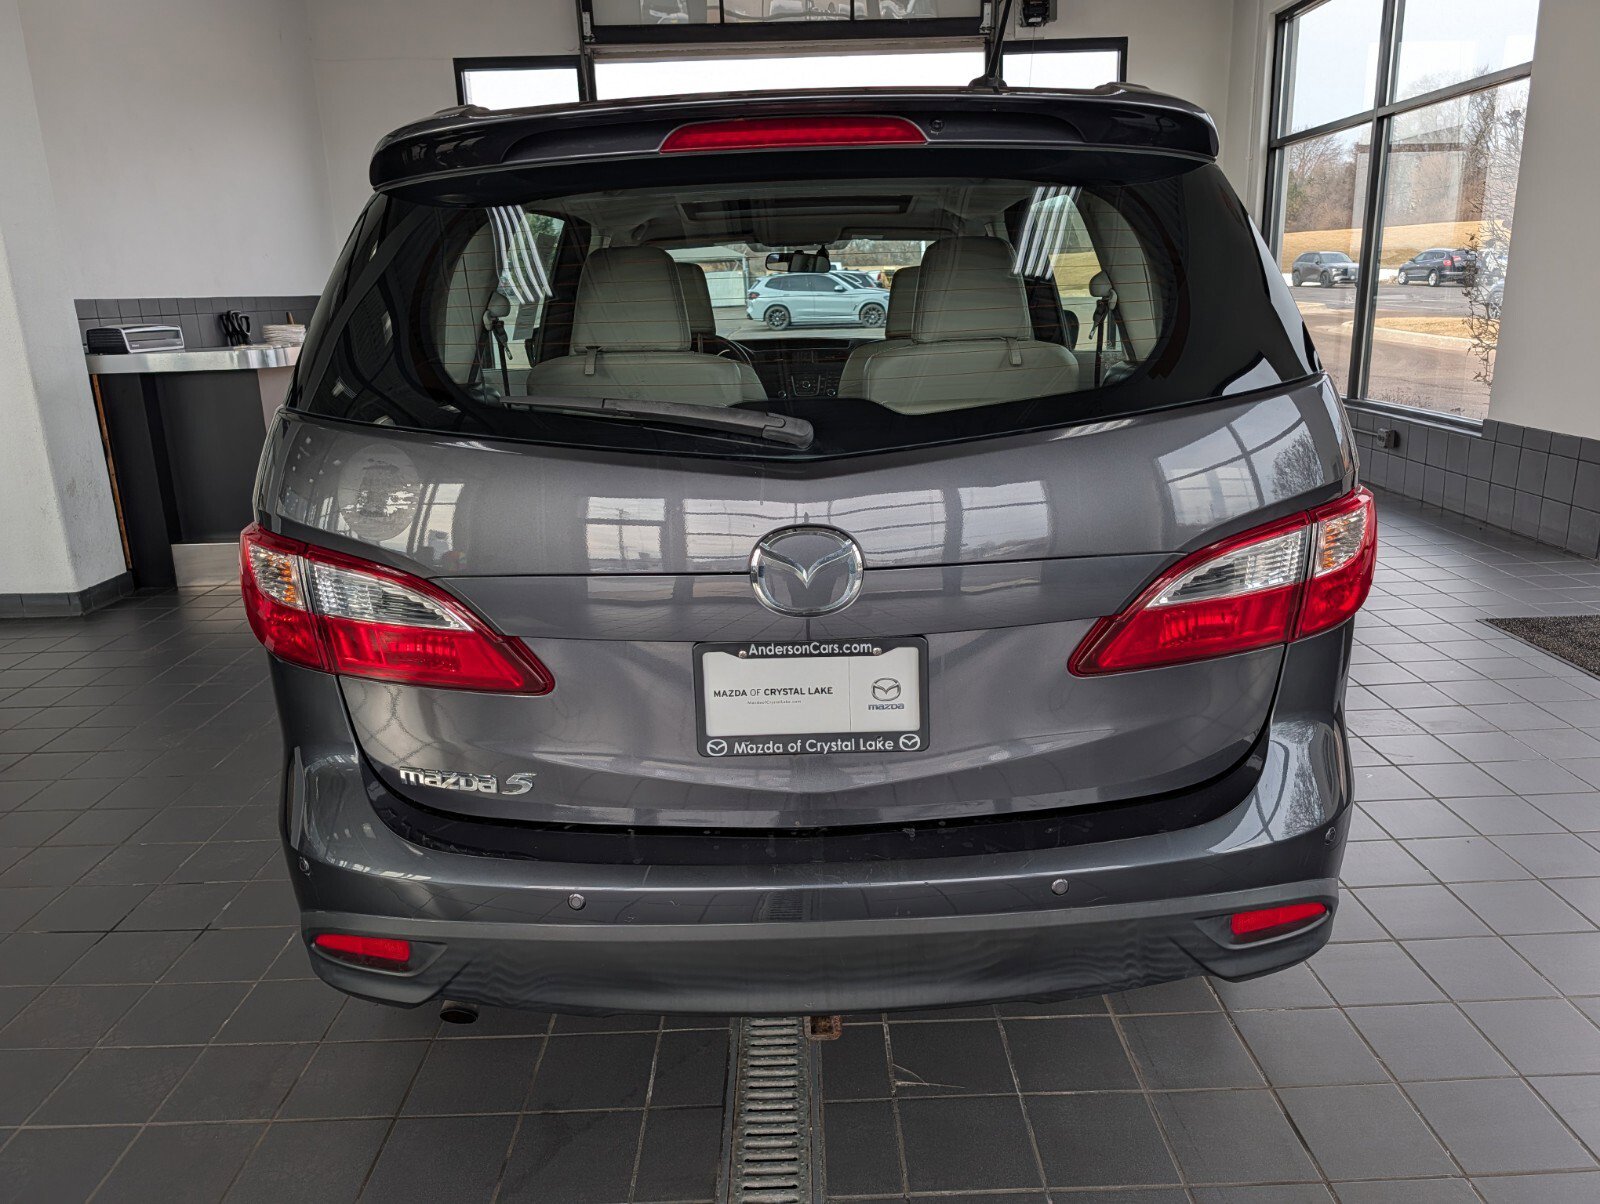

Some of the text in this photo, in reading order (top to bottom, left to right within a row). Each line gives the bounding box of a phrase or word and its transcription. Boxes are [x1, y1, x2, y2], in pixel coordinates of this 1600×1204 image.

[748, 641, 873, 656] AndersonCars.com
[713, 686, 834, 698] MAZDA OF CRYSTAL LAKE
[733, 736, 894, 755] Mazda of Crystal Lake
[399, 765, 537, 796] mazda 5
